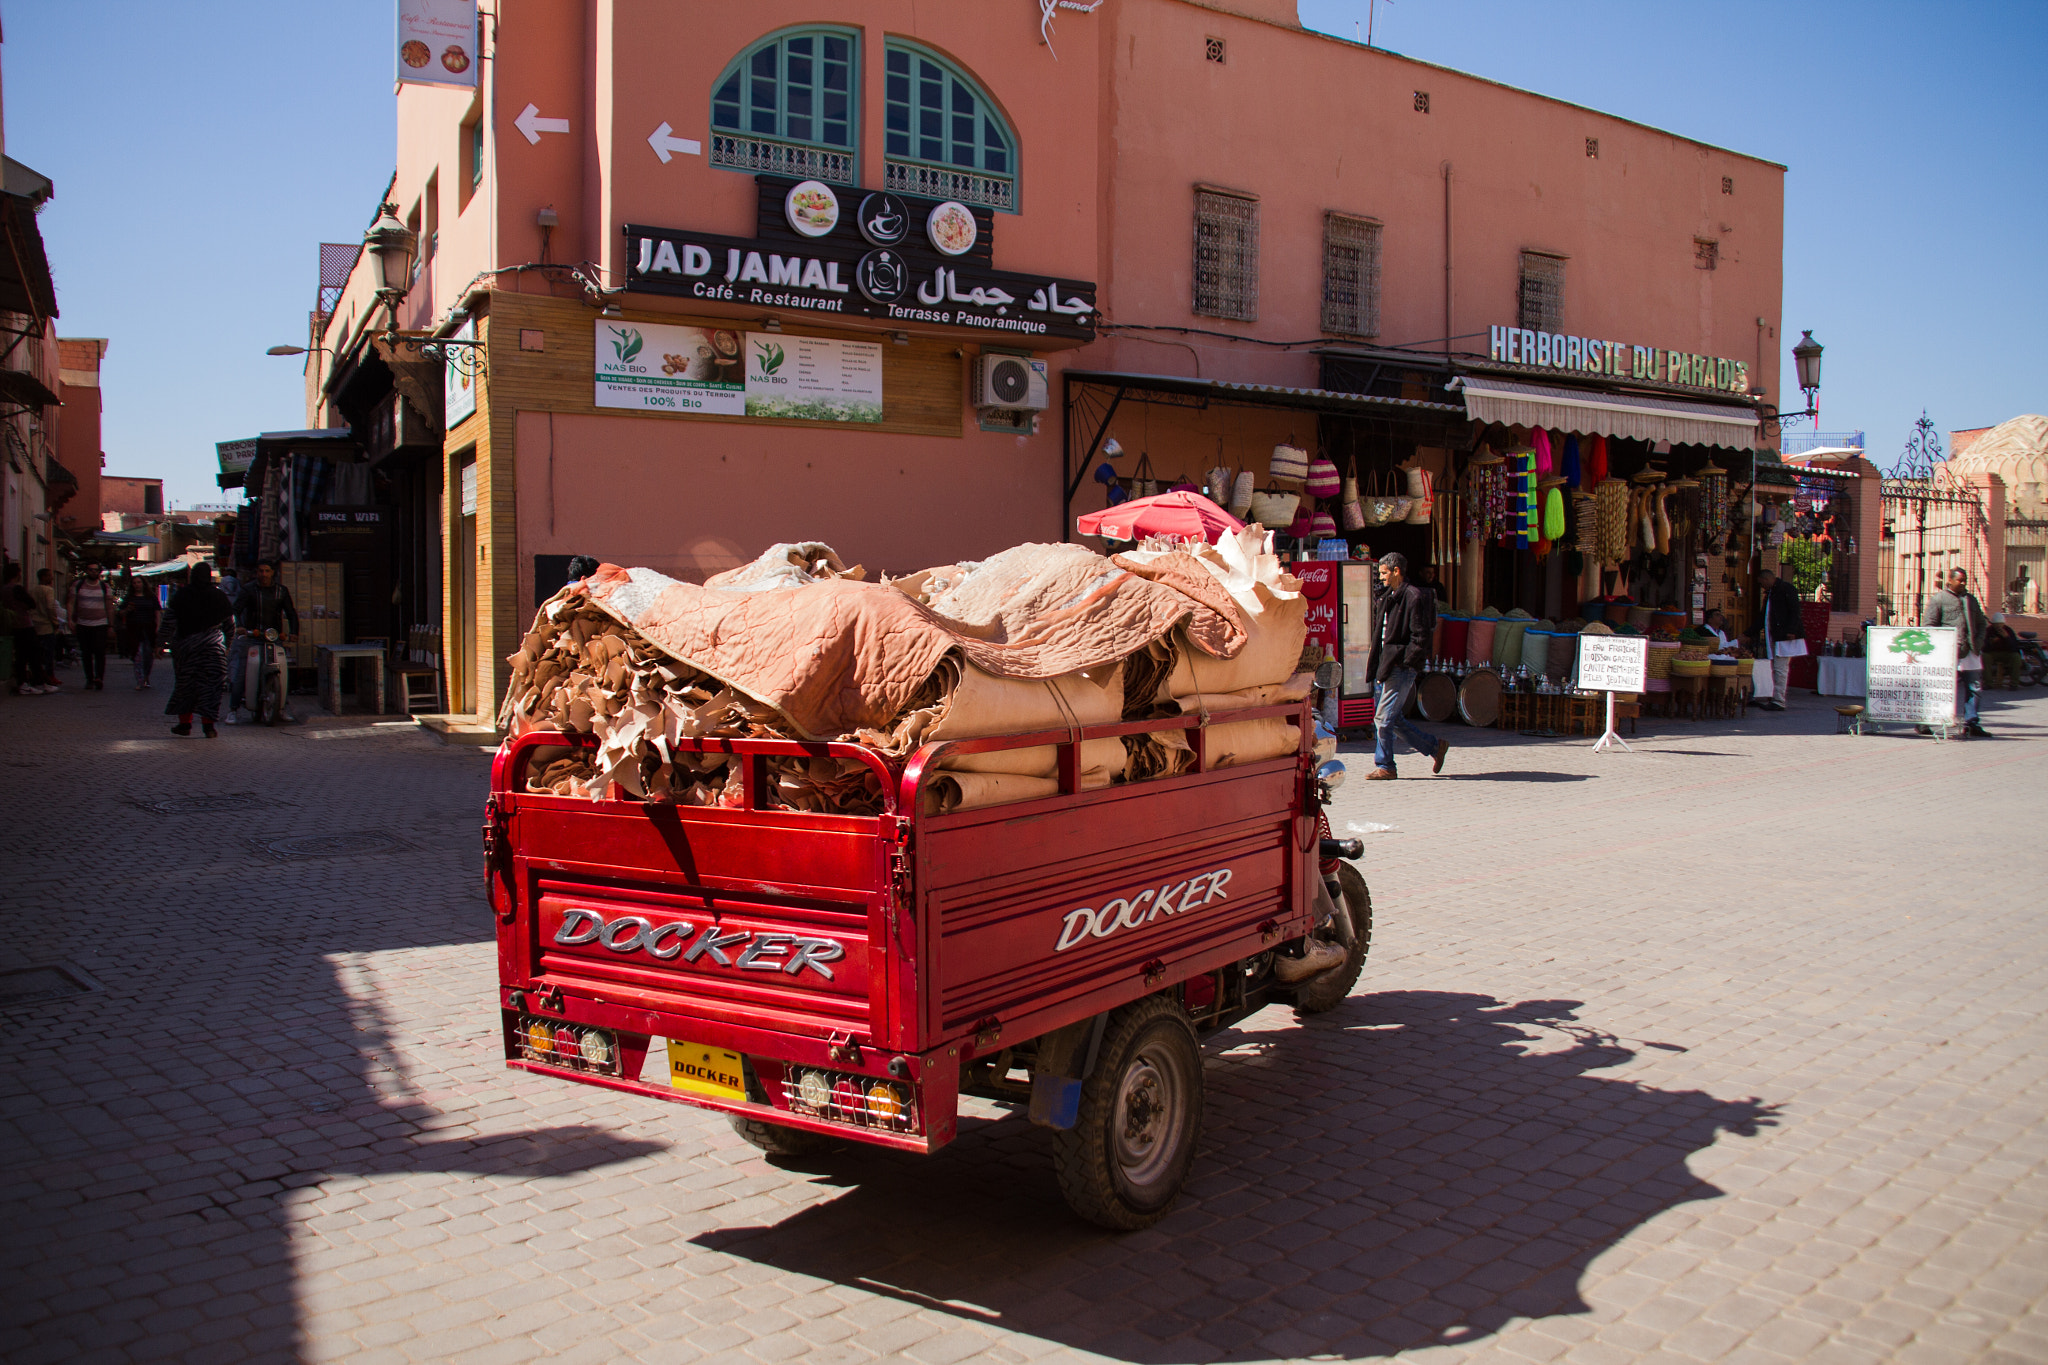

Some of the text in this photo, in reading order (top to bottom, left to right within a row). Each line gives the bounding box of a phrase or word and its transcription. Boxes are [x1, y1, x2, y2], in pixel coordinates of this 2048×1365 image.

[636, 238, 849, 292] JAD JAMAL
[917, 266, 1095, 326] جاد جمال
[693, 281, 734, 300] Café
[750, 288, 843, 311] Restaurant
[888, 303, 950, 322] Terrasse
[956, 311, 1047, 334] Panoramique
[604, 363, 647, 373] NAS BIO
[1488, 325, 1750, 393] HERBORISTE DU PARADIS
[750, 375, 769, 383] NAS
[644, 396, 702, 408] 100% BIO
[318, 513, 347, 521] ESPACE
[1870, 664, 1953, 677] HERBORISTE DU PARADIS
[1910, 679, 1921, 688] DES
[1869, 689, 1901, 699] HERBORIST
[1903, 690, 1911, 700] OF
[1912, 691, 1924, 700] THE
[1054, 868, 1232, 952] DOCKER
[553, 908, 845, 980] DOCKER
[674, 1061, 739, 1087] DOCKER
